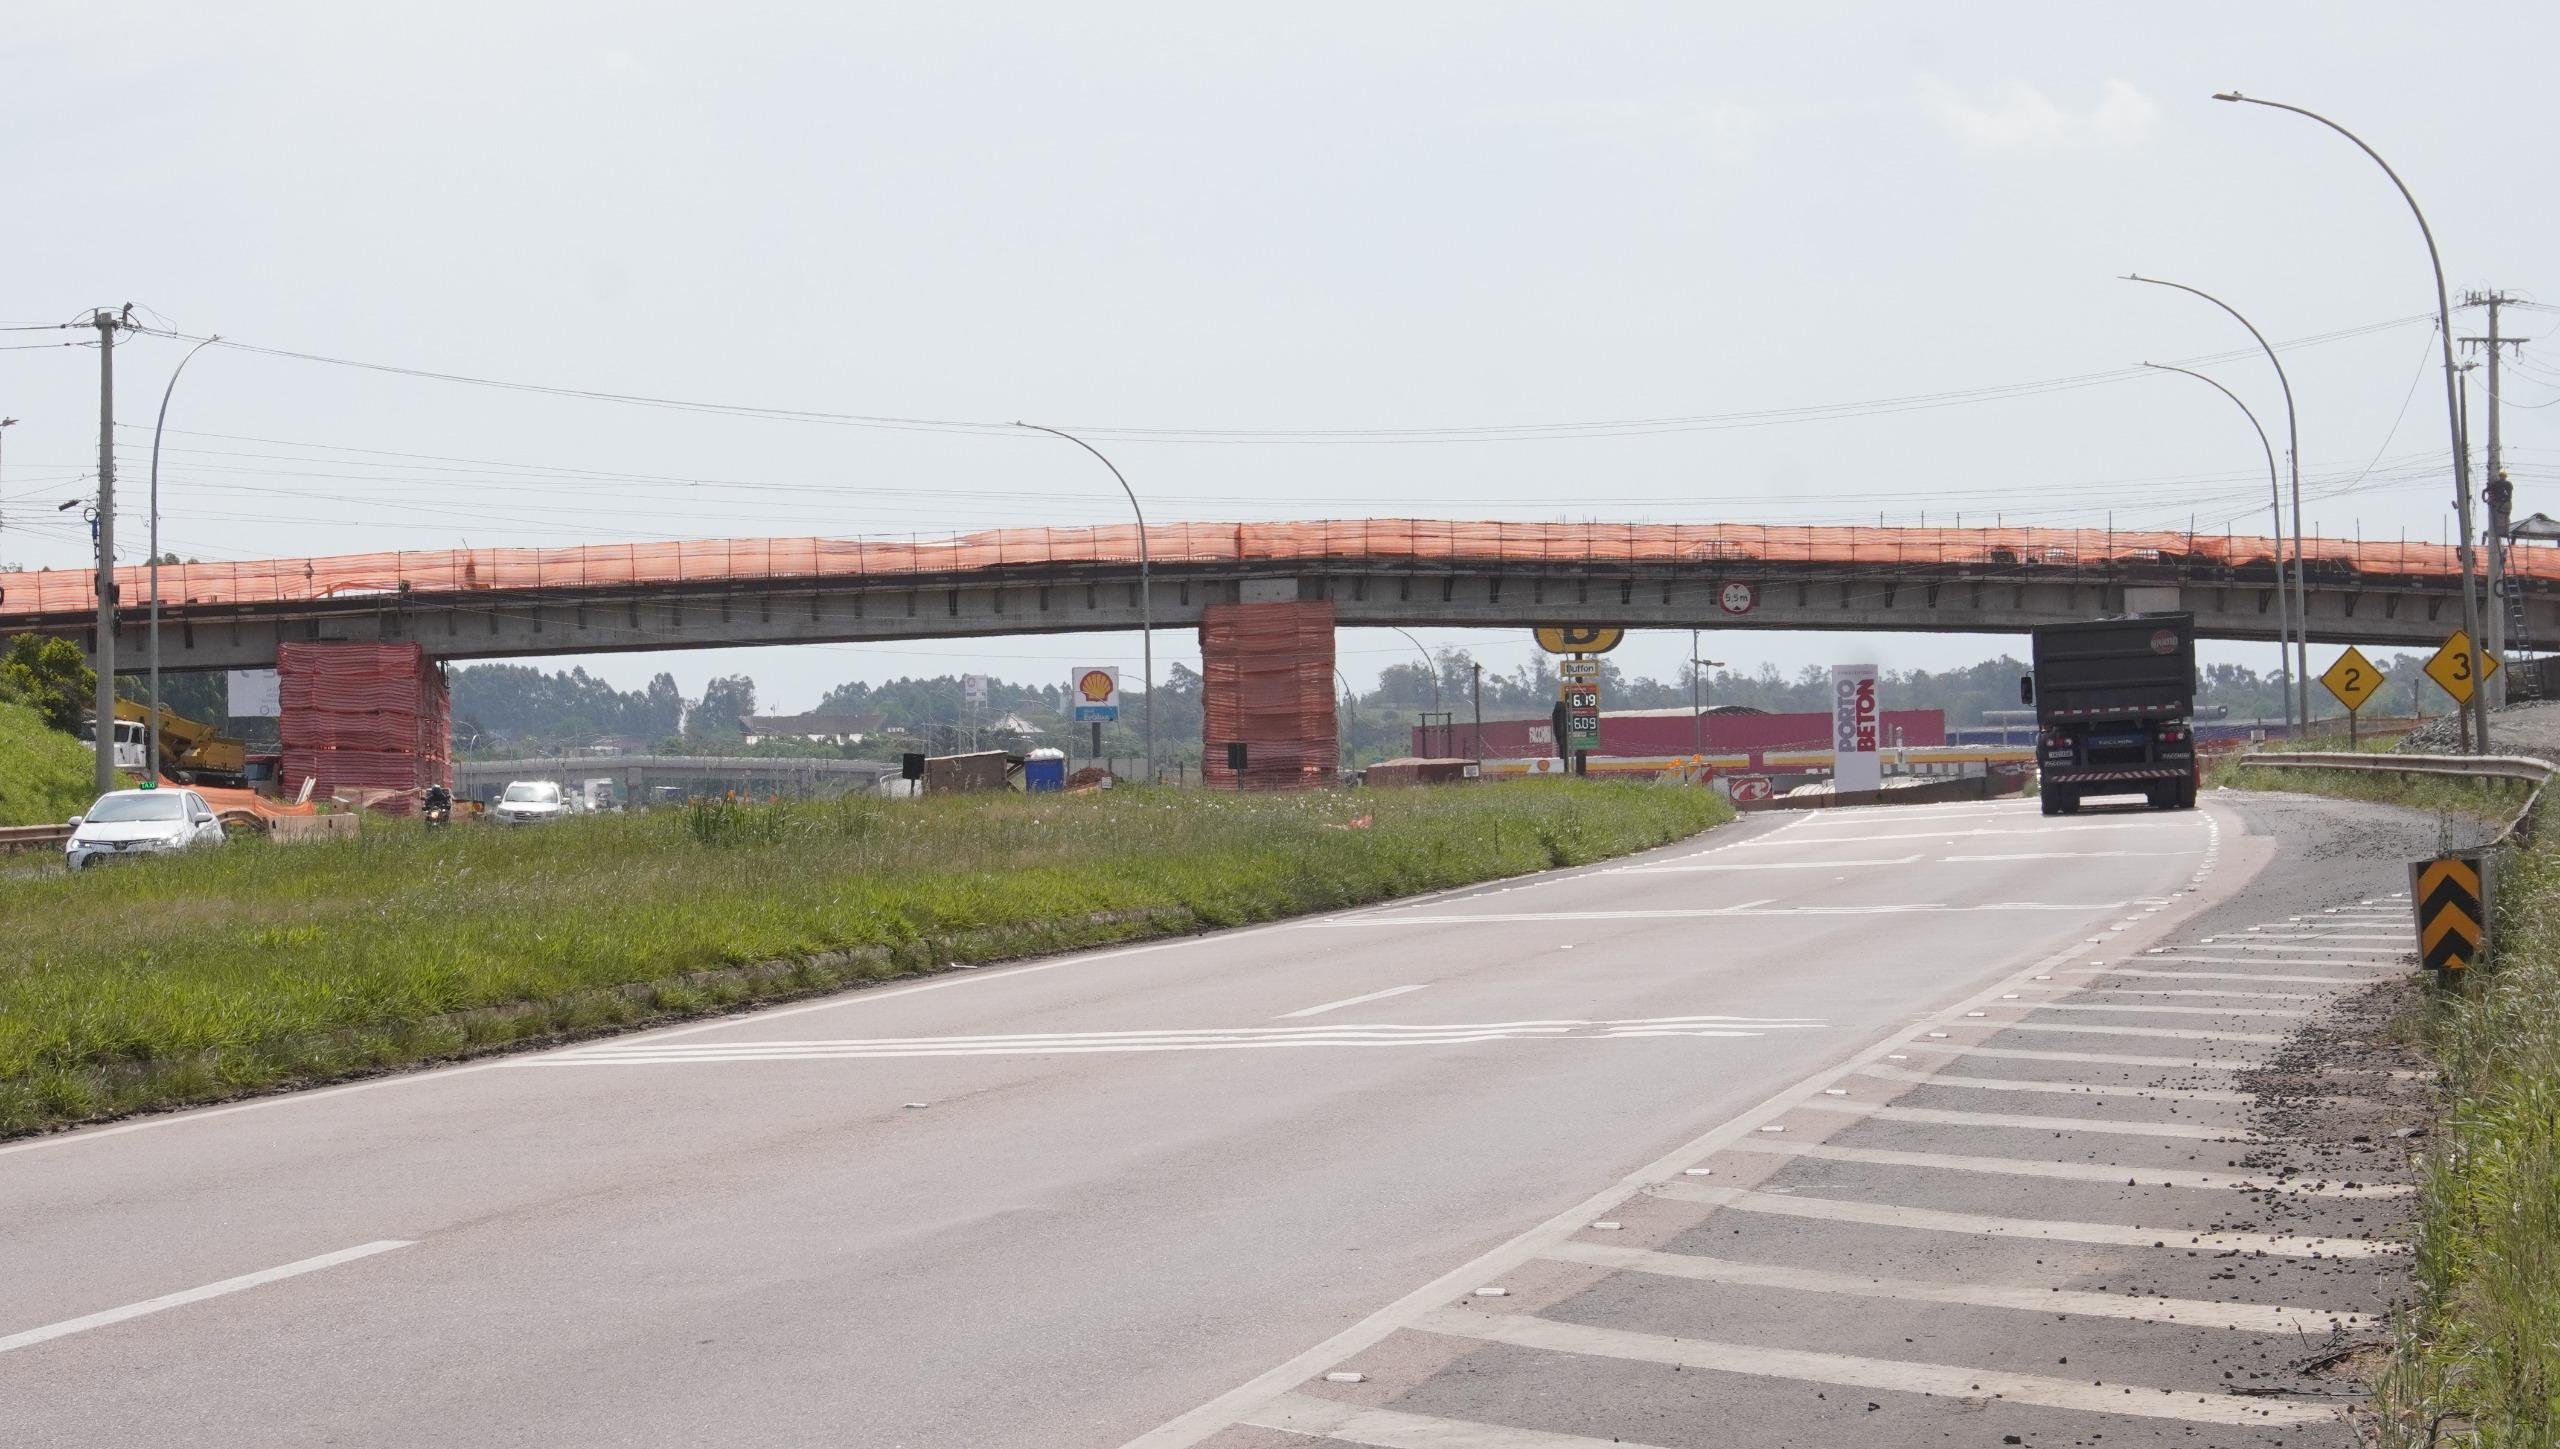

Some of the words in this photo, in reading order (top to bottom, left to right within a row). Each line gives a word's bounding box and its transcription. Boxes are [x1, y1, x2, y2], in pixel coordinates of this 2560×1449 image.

[2453, 653, 2471, 680] 3
[2345, 668, 2360, 691] 2
[1573, 694, 1596, 706] 6.19
[1574, 717, 1596, 730] 6.09
[1837, 679, 1856, 752] PORTO
[1856, 679, 1876, 752] BETON
